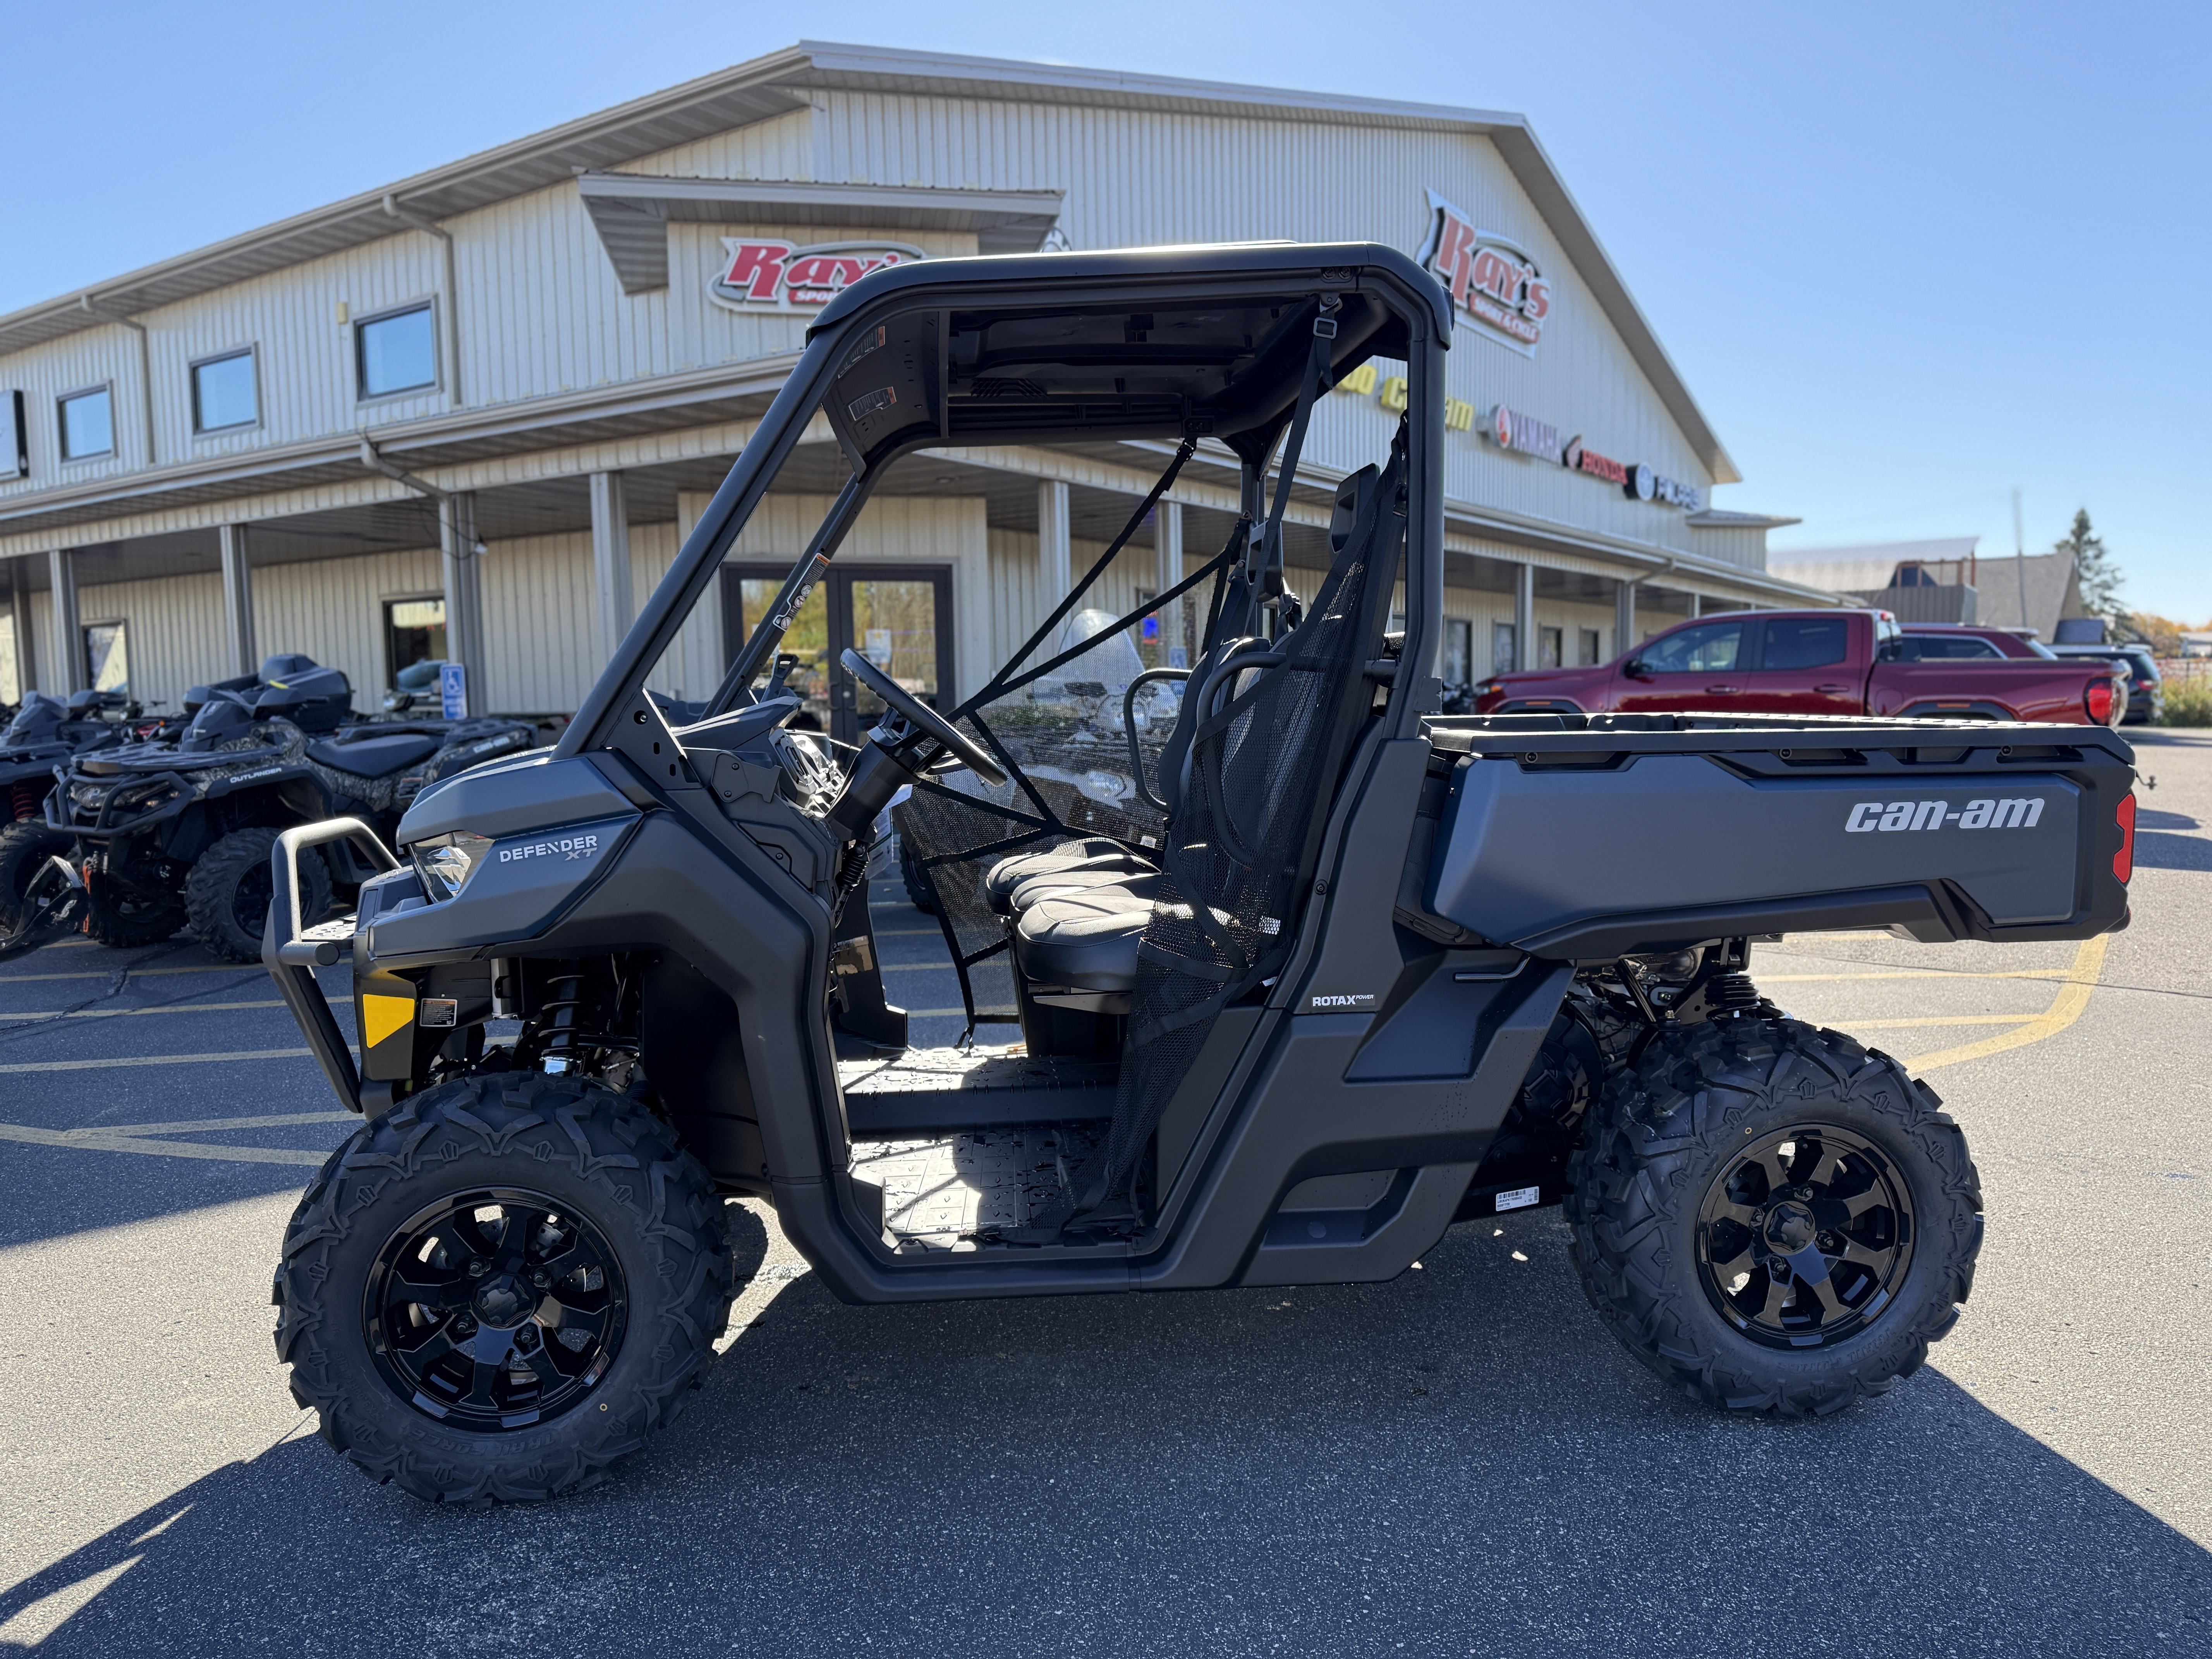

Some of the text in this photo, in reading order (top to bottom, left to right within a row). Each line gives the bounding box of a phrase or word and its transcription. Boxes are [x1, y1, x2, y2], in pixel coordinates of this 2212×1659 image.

[723, 243, 901, 301] Ray'
[1582, 449, 1628, 485] HONDA
[230, 768, 282, 783] OUTLANDER
[1845, 798, 2045, 832] can-am
[500, 835, 597, 862] DEFENDER
[565, 847, 597, 860] XT
[1312, 995, 1356, 1006] ROTAX
[408, 1427, 488, 1457] FORCE
